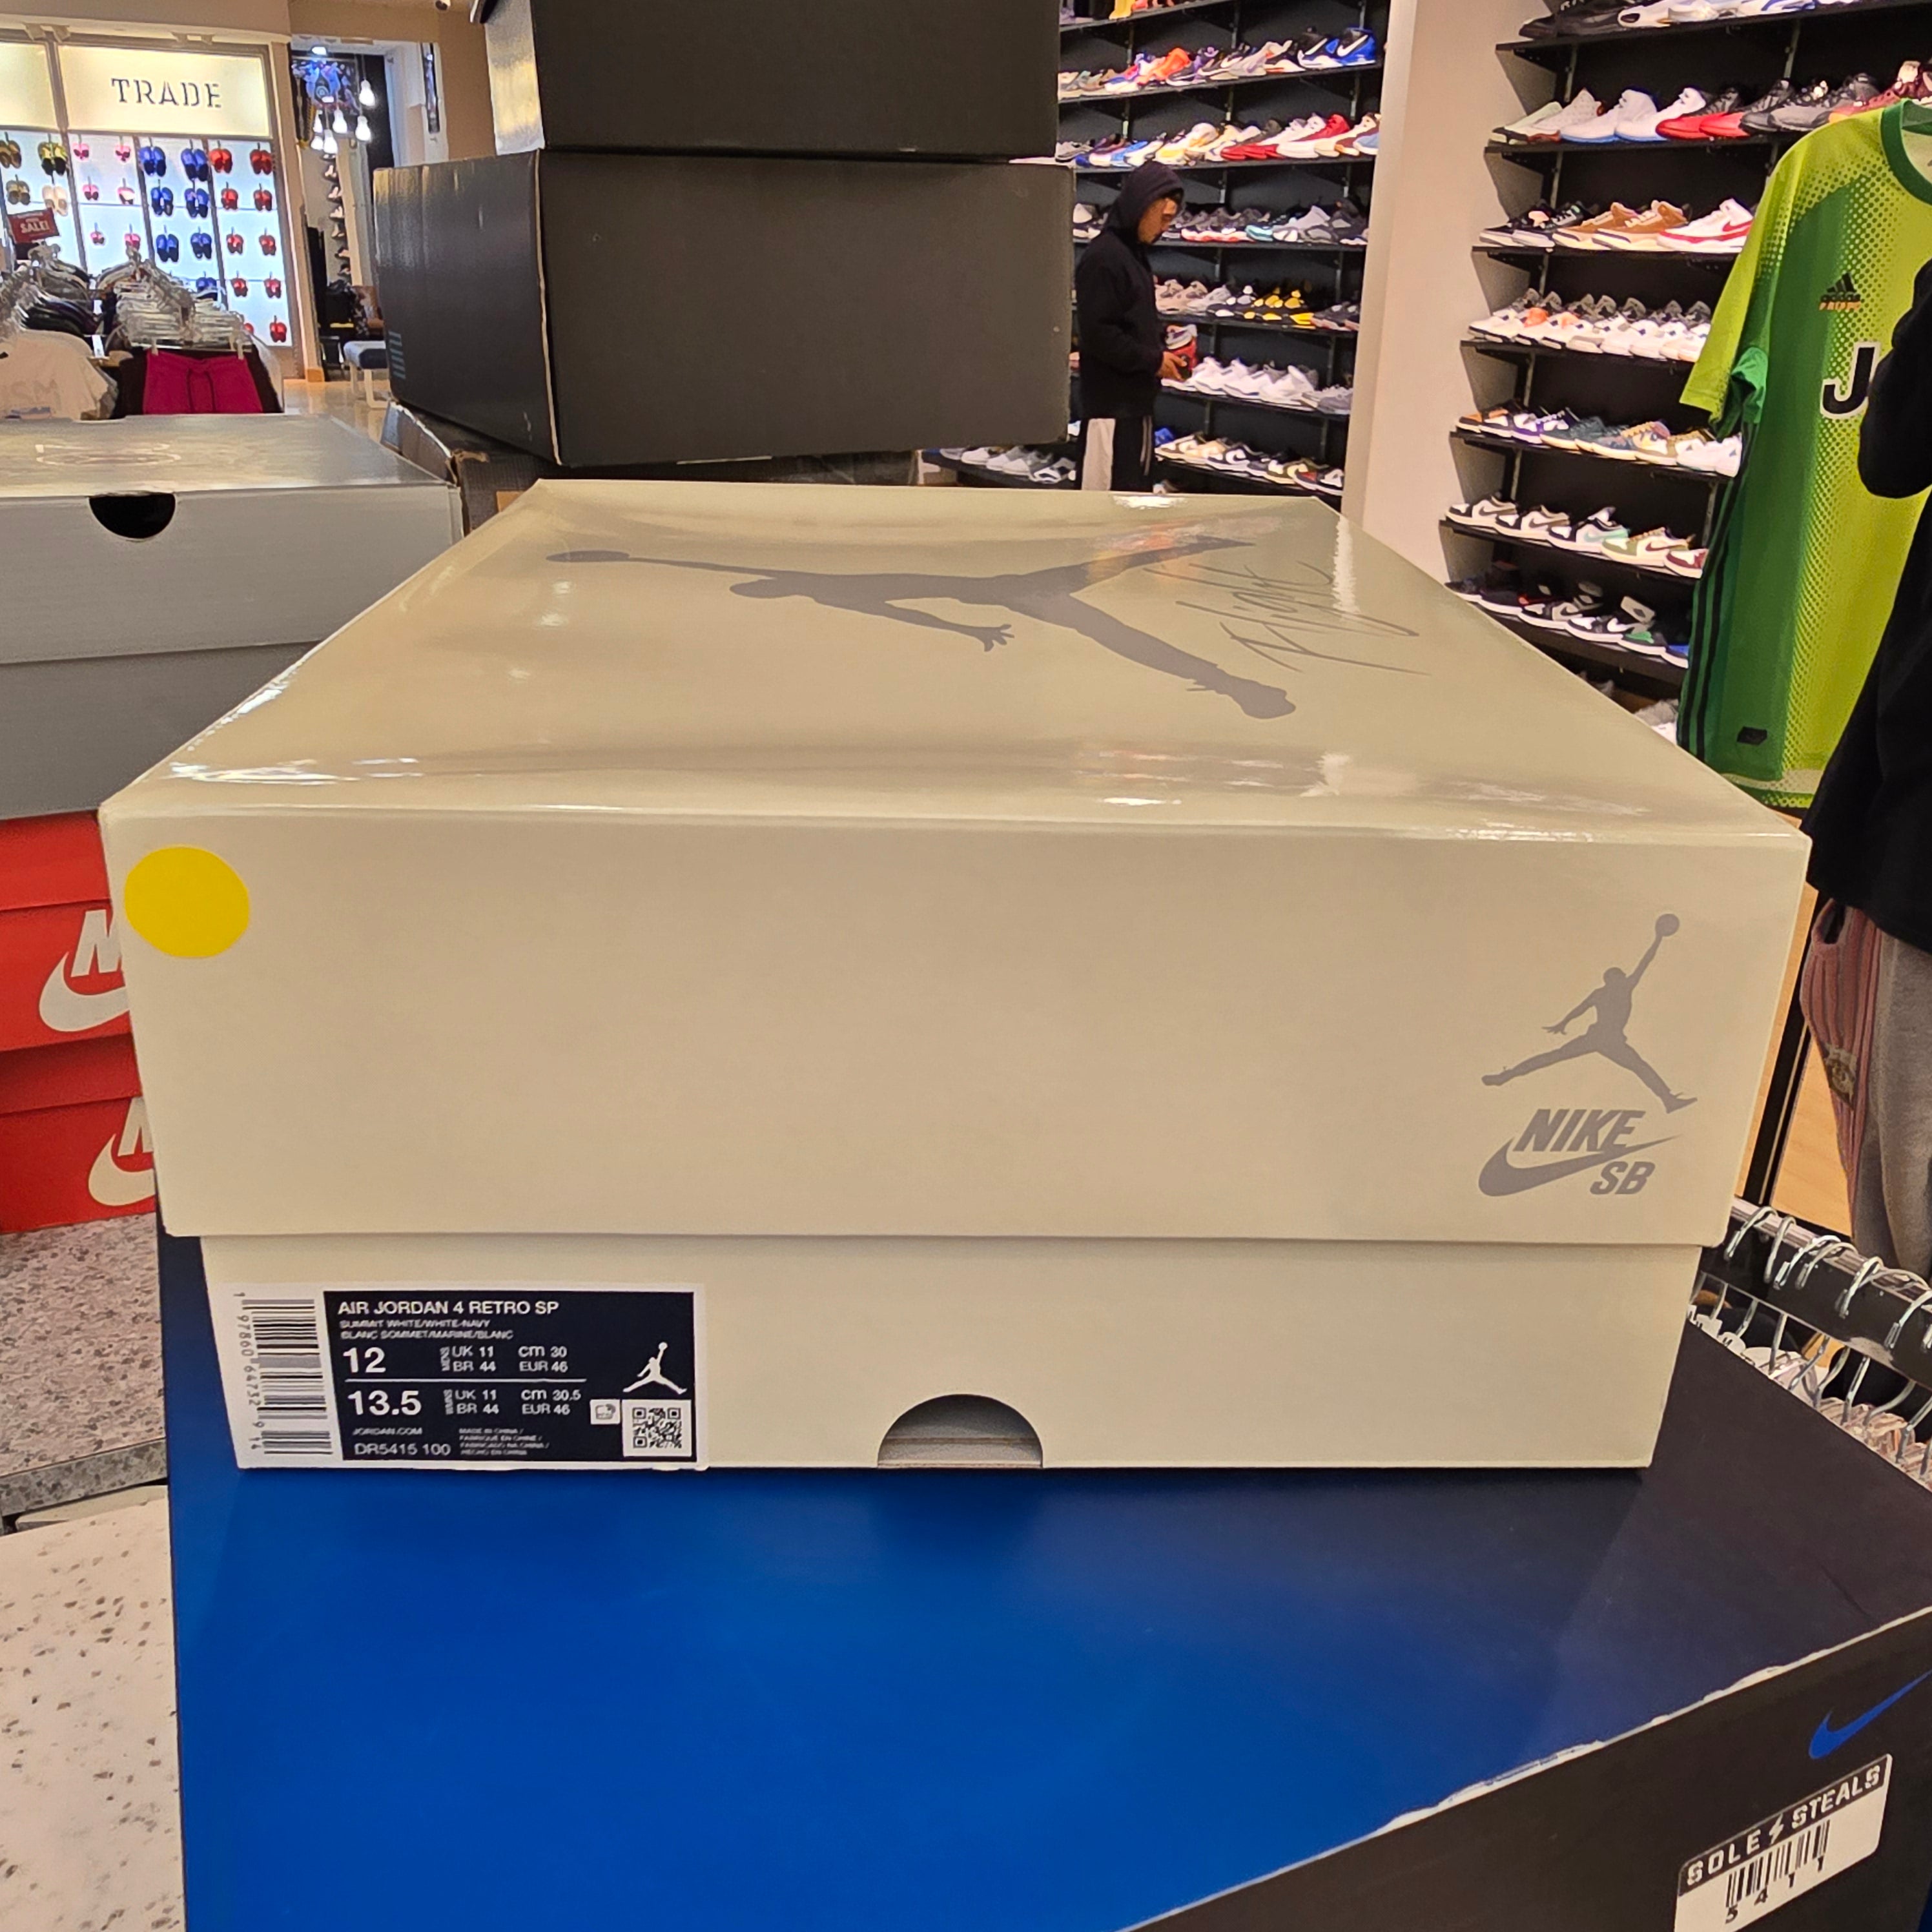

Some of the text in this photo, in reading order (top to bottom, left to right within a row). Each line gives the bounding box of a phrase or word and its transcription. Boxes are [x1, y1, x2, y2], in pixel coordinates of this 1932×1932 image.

[111, 78, 221, 108] TRADE
[1513, 1108, 1646, 1152] NIKE
[1590, 1161, 1656, 1195] SB
[338, 1300, 559, 1315] AIR JORDAN 4 RETRO SP
[340, 1330, 378, 1340] BLANC
[343, 1347, 386, 1373] 12
[452, 1345, 473, 1357] UK
[479, 1346, 494, 1357] 11
[550, 1346, 567, 1357] 30
[453, 1361, 568, 1372] BR 44 EUR 46
[347, 1390, 422, 1415] 13.5
[455, 1389, 476, 1401] UK
[482, 1389, 497, 1401] 11
[552, 1389, 581, 1401] 30.5
[457, 1403, 570, 1415] BR 44 EUR 46
[354, 1443, 418, 1455] DR5415
[422, 1443, 451, 1455] 100
[1687, 1765, 1880, 1886] SOLE STEALS
[1725, 1855, 1825, 1924] 5411
